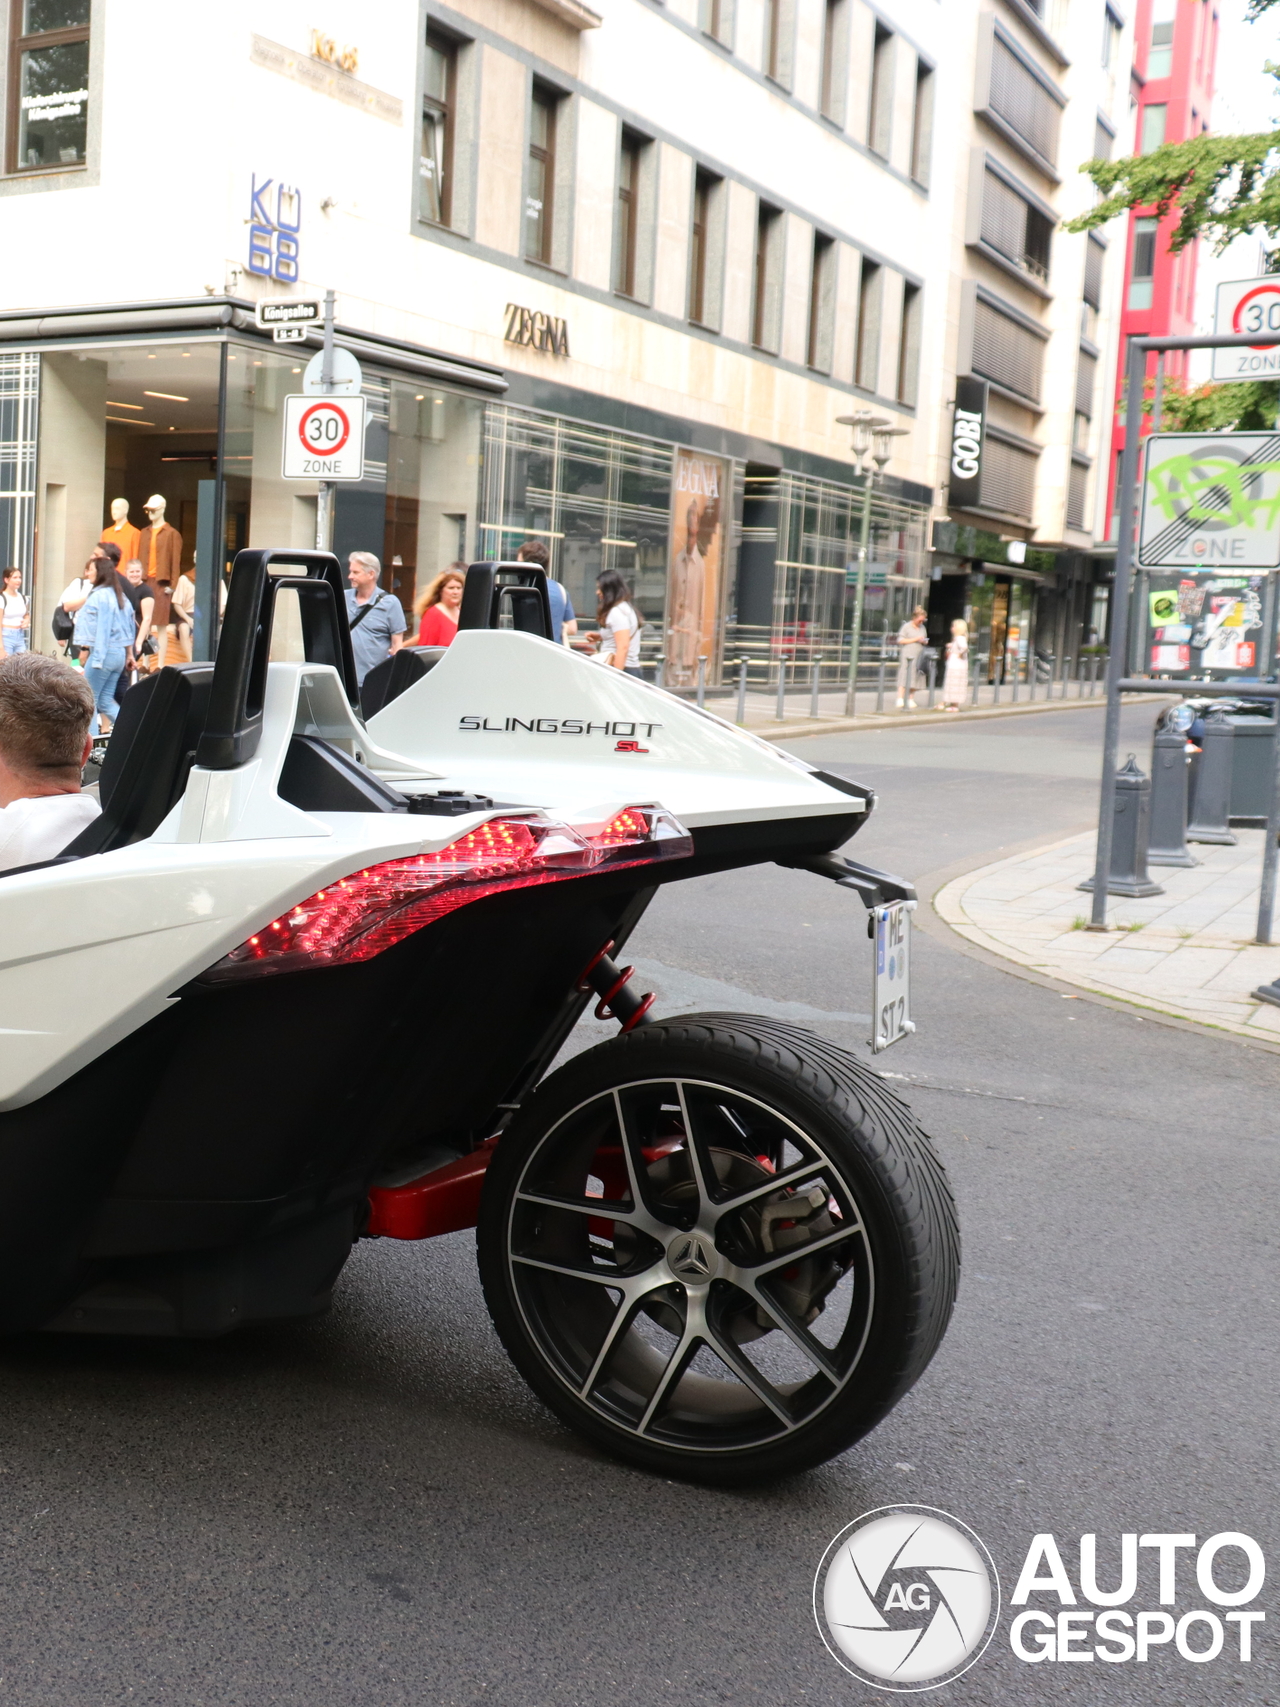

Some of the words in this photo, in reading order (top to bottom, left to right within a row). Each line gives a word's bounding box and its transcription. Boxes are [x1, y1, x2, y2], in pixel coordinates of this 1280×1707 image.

[248, 224, 299, 283] 68
[264, 303, 315, 321] Königsallee
[1246, 302, 1280, 333] 30
[504, 302, 572, 358] ZEGNA
[309, 417, 339, 442] 30
[951, 407, 982, 479] GOBI
[303, 460, 342, 473] ZONE
[675, 456, 720, 498] EGNA
[1174, 538, 1248, 559] ZONE
[458, 715, 665, 738] SLINGSHOT
[614, 740, 650, 753] SL
[888, 906, 905, 948] ME
[881, 1000, 897, 1040] ST
[898, 995, 906, 1034] 2
